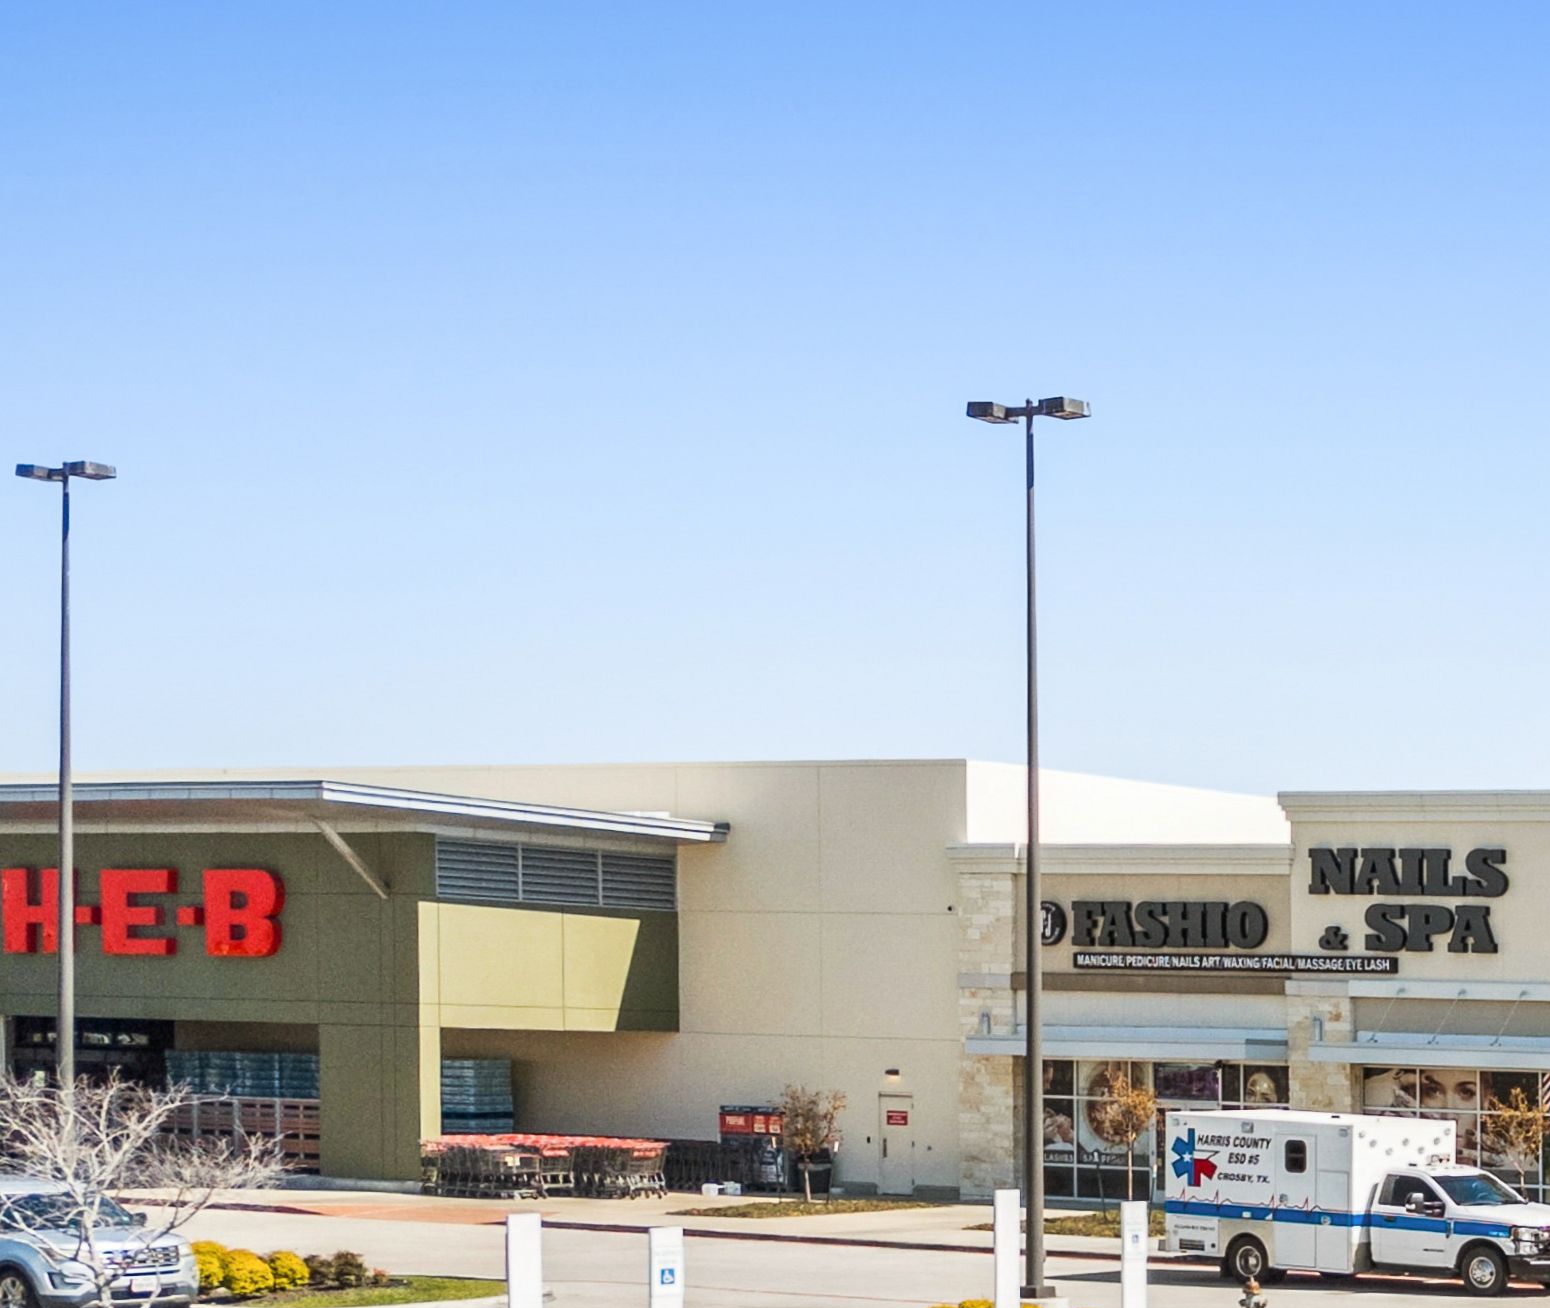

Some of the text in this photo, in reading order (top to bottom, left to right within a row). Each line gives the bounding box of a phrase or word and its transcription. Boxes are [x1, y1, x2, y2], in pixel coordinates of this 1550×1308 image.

[1308, 846, 1510, 898] NAILS
[2, 866, 285, 958] H-E-B
[1071, 900, 1269, 948] FASHIO
[1318, 903, 1499, 954] & SPA
[1364, 958, 1390, 971] LASH
[1197, 1134, 1272, 1149] HARRIS COUNTY
[1227, 1152, 1260, 1165] ESD #5
[1217, 1172, 1270, 1184] CROSBY, TX.
